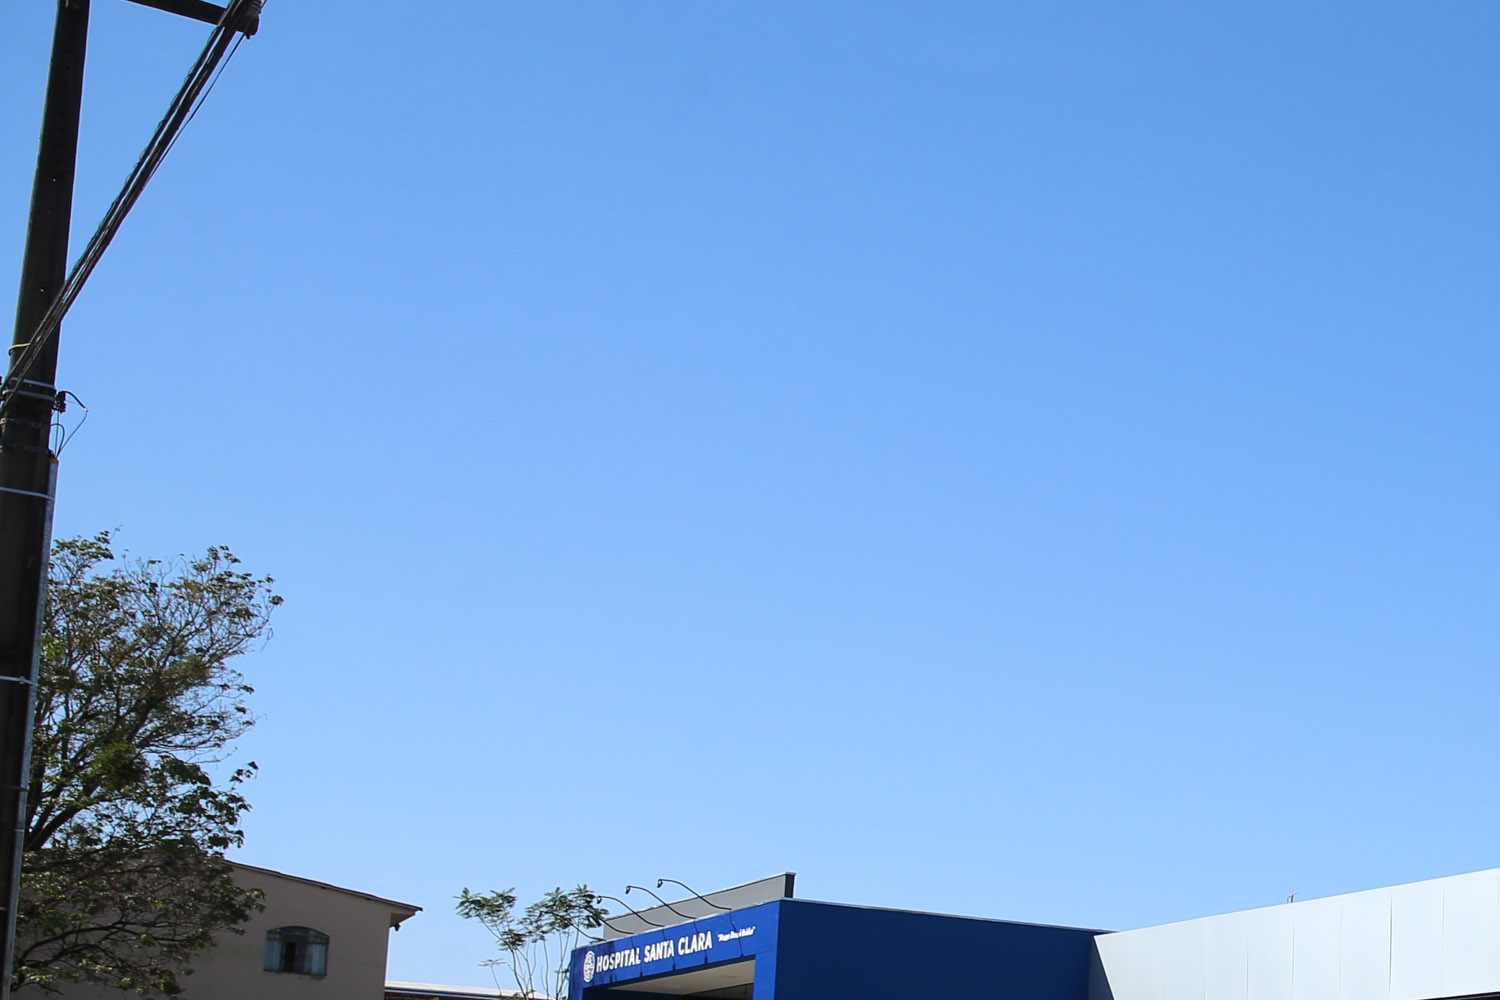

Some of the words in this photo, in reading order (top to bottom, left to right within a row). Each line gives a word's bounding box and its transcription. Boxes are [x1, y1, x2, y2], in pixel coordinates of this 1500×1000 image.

[596, 947, 641, 973] HOSPITAL
[644, 940, 675, 963] SANTA
[678, 931, 713, 956] CLARA
